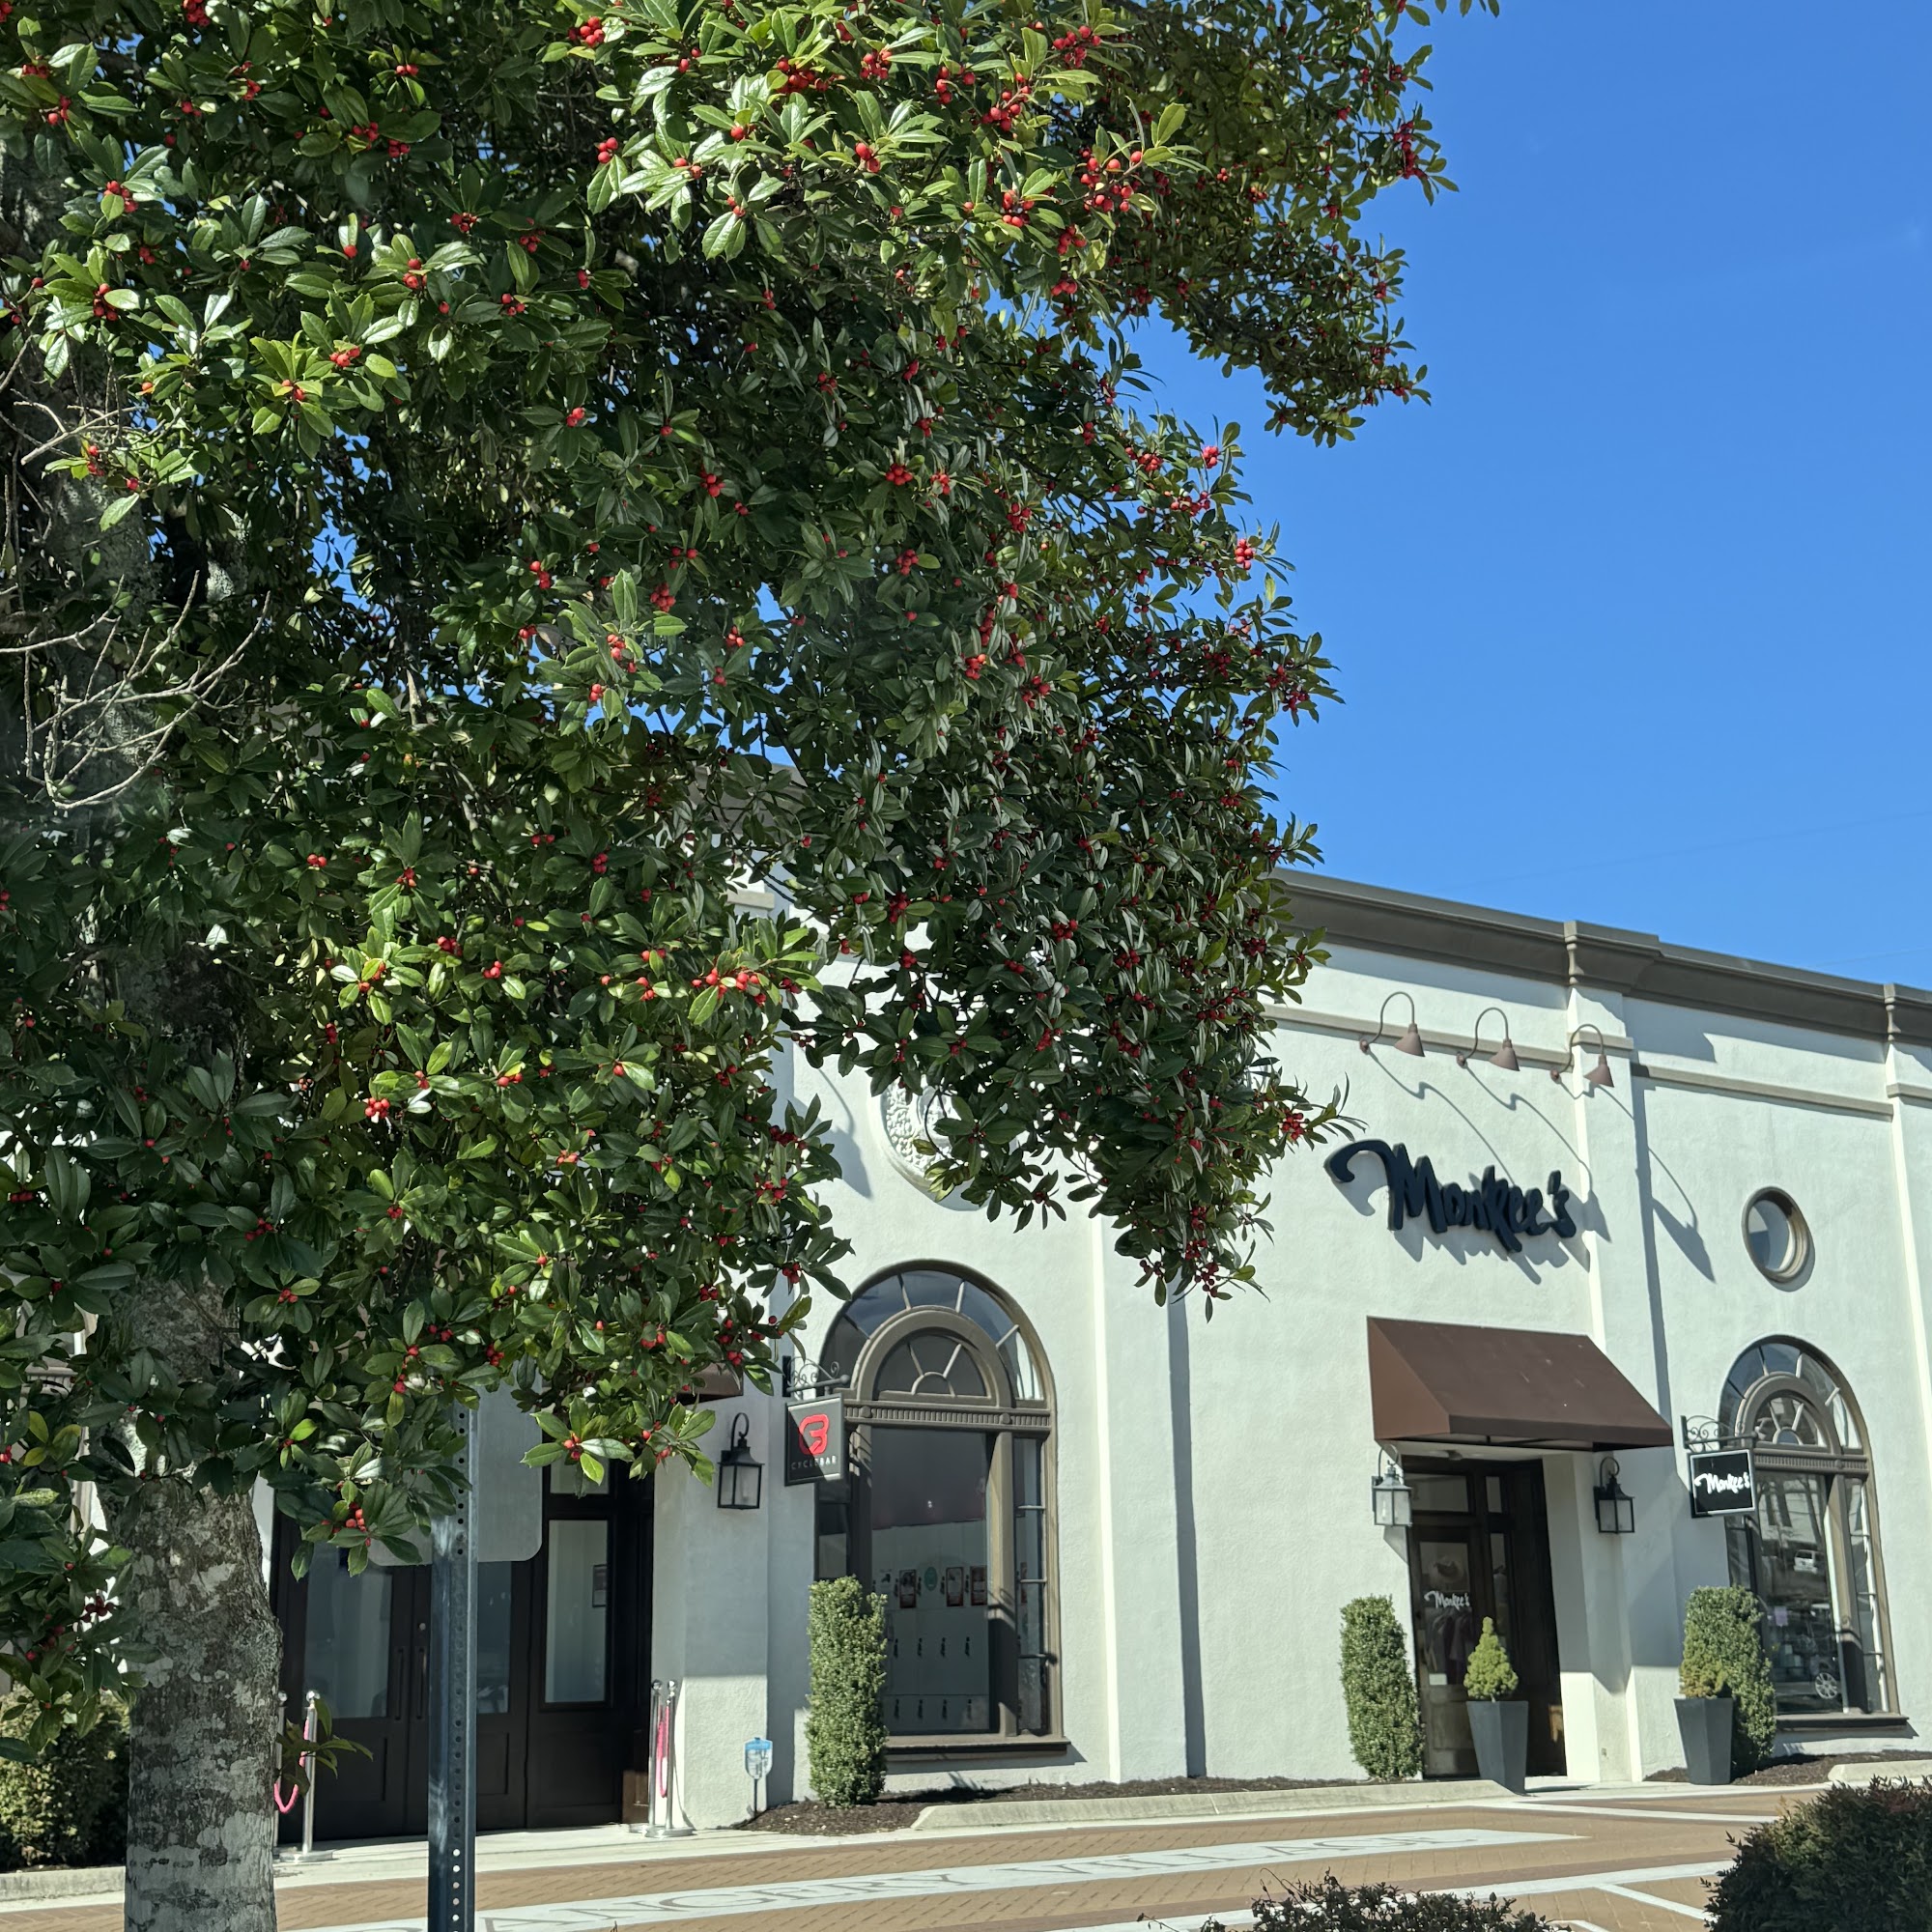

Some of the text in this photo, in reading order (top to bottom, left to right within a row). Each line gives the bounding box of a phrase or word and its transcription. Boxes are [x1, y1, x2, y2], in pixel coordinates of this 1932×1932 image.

[1323, 1139, 1577, 1253] Monkee's
[791, 1455, 837, 1469] CYCLEBAR
[1693, 1471, 1749, 1494] Monkee's
[1423, 1590, 1470, 1611] Monkee's
[355, 1836, 1479, 1932] ANGERY VILLAGE
